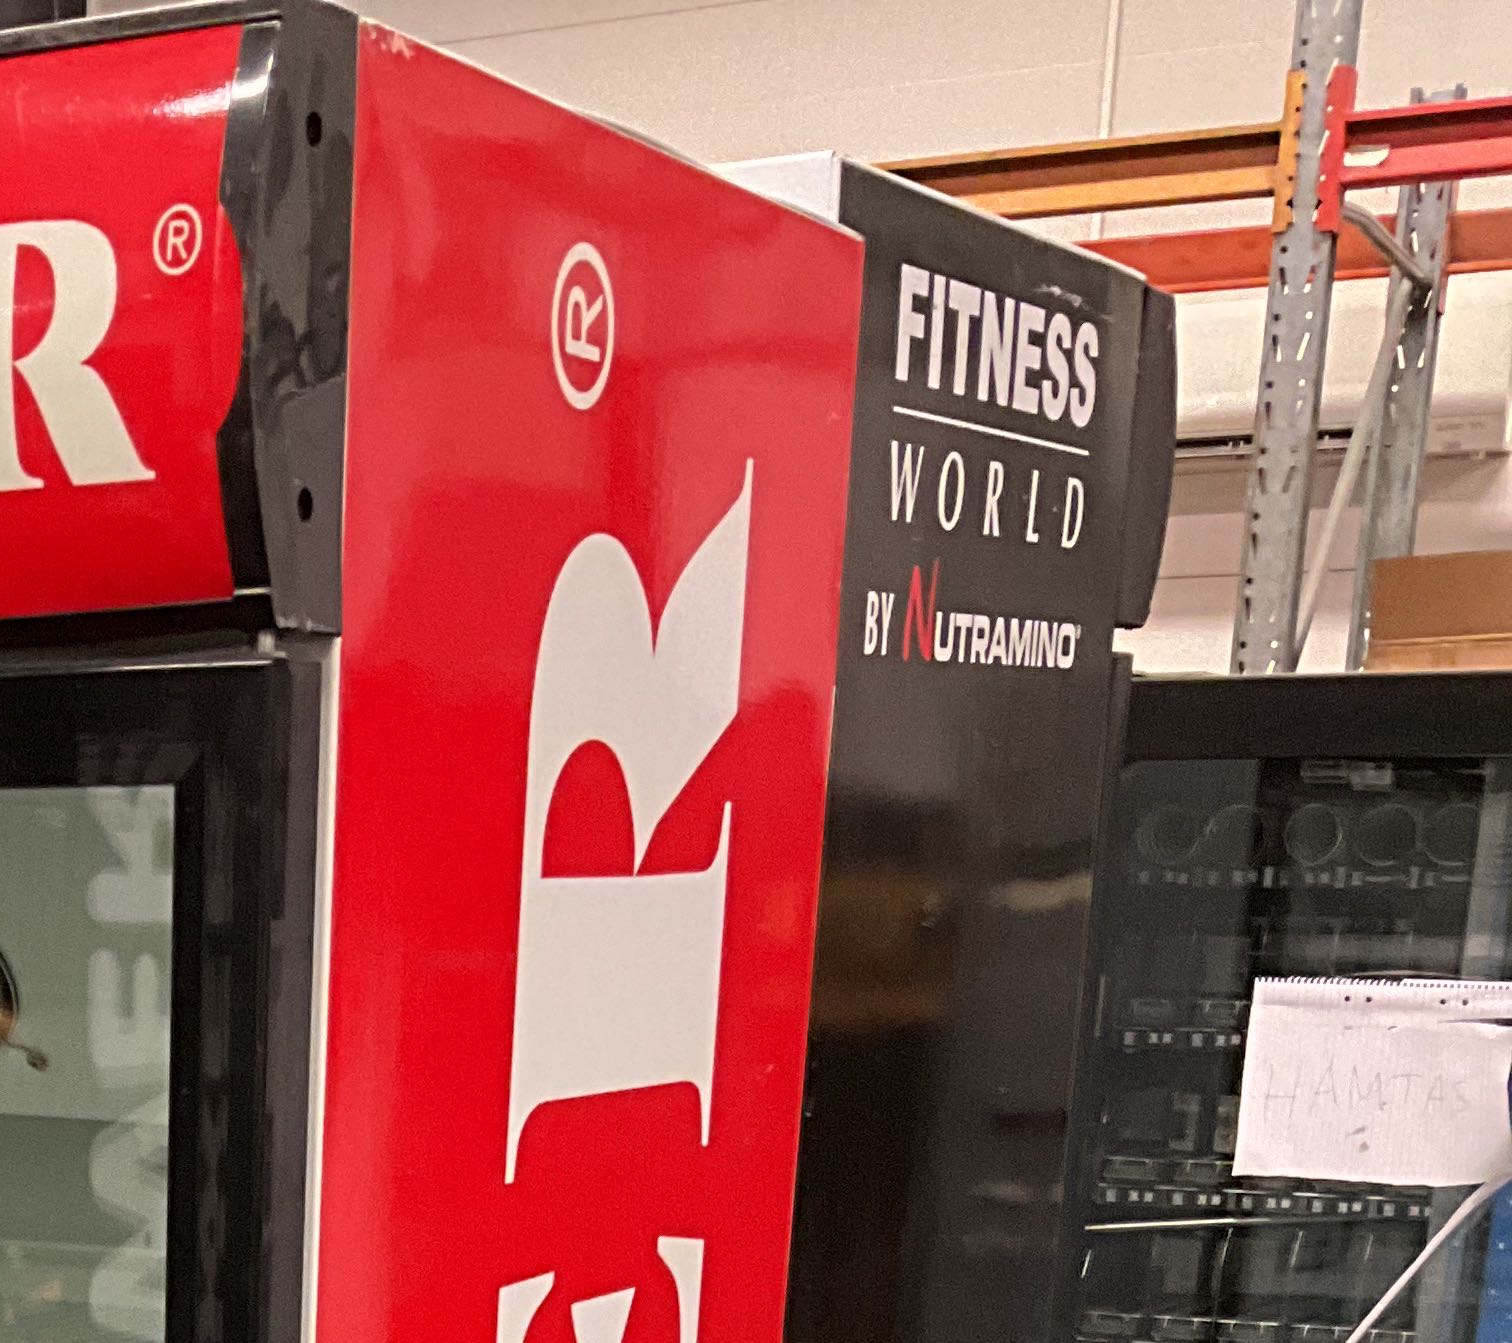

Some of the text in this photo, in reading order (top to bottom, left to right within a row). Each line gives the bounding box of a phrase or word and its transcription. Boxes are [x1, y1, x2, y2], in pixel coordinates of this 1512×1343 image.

[894, 262, 1099, 428] FITNESS
[890, 439, 1086, 549] WORLD
[863, 590, 895, 657] BY
